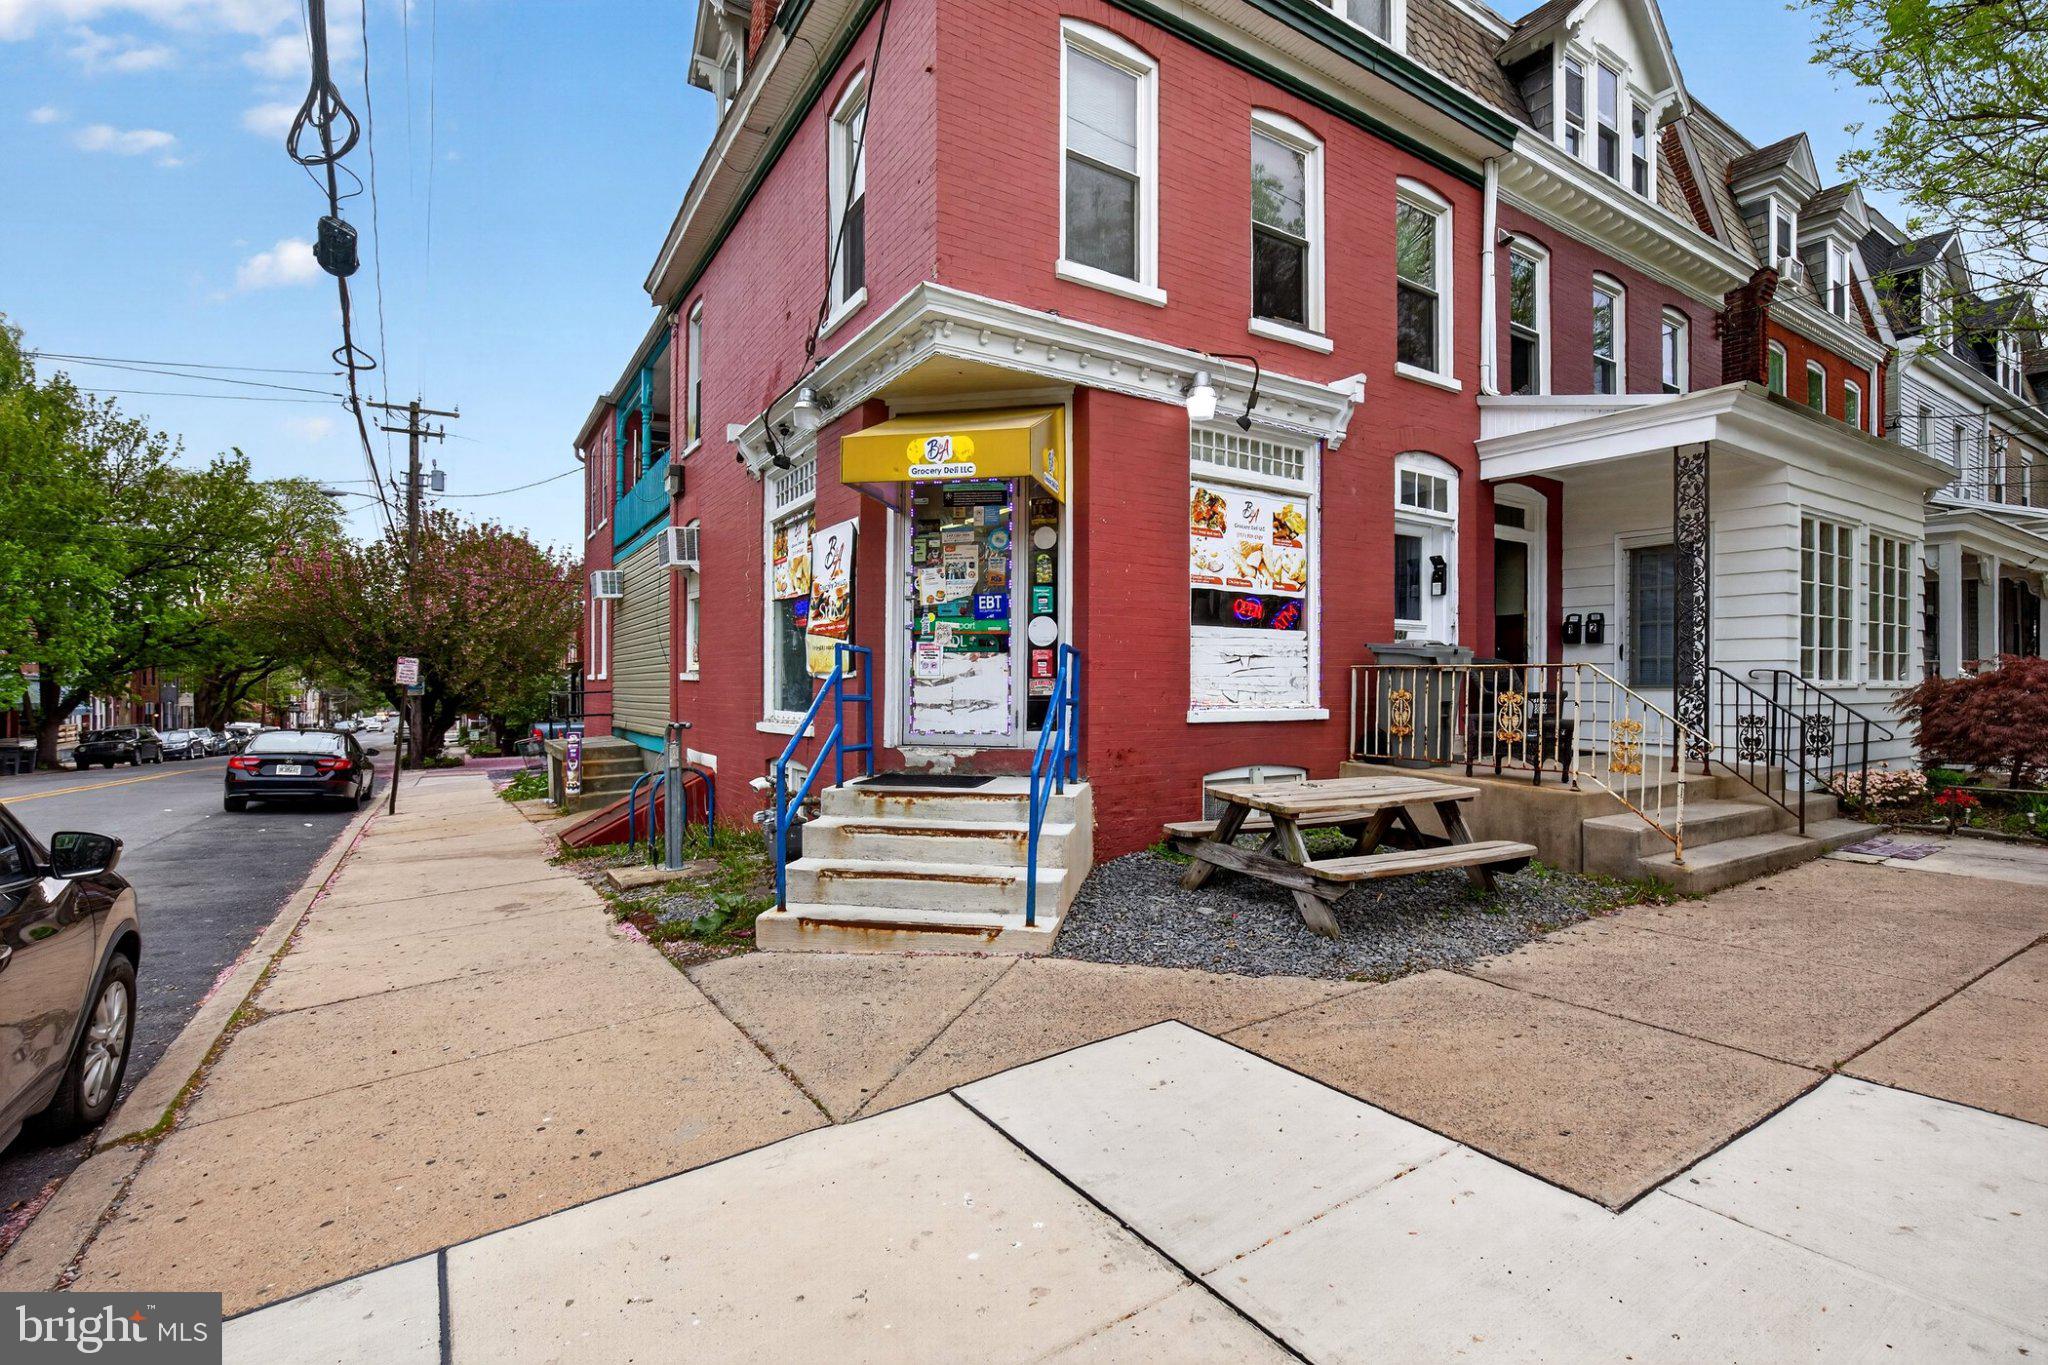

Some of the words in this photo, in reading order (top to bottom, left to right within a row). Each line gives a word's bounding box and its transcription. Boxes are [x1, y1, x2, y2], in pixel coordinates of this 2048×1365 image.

[911, 467, 942, 475] Grocery
[944, 466, 959, 474] Deli
[960, 466, 973, 474] LLC
[979, 595, 1002, 609] EBT
